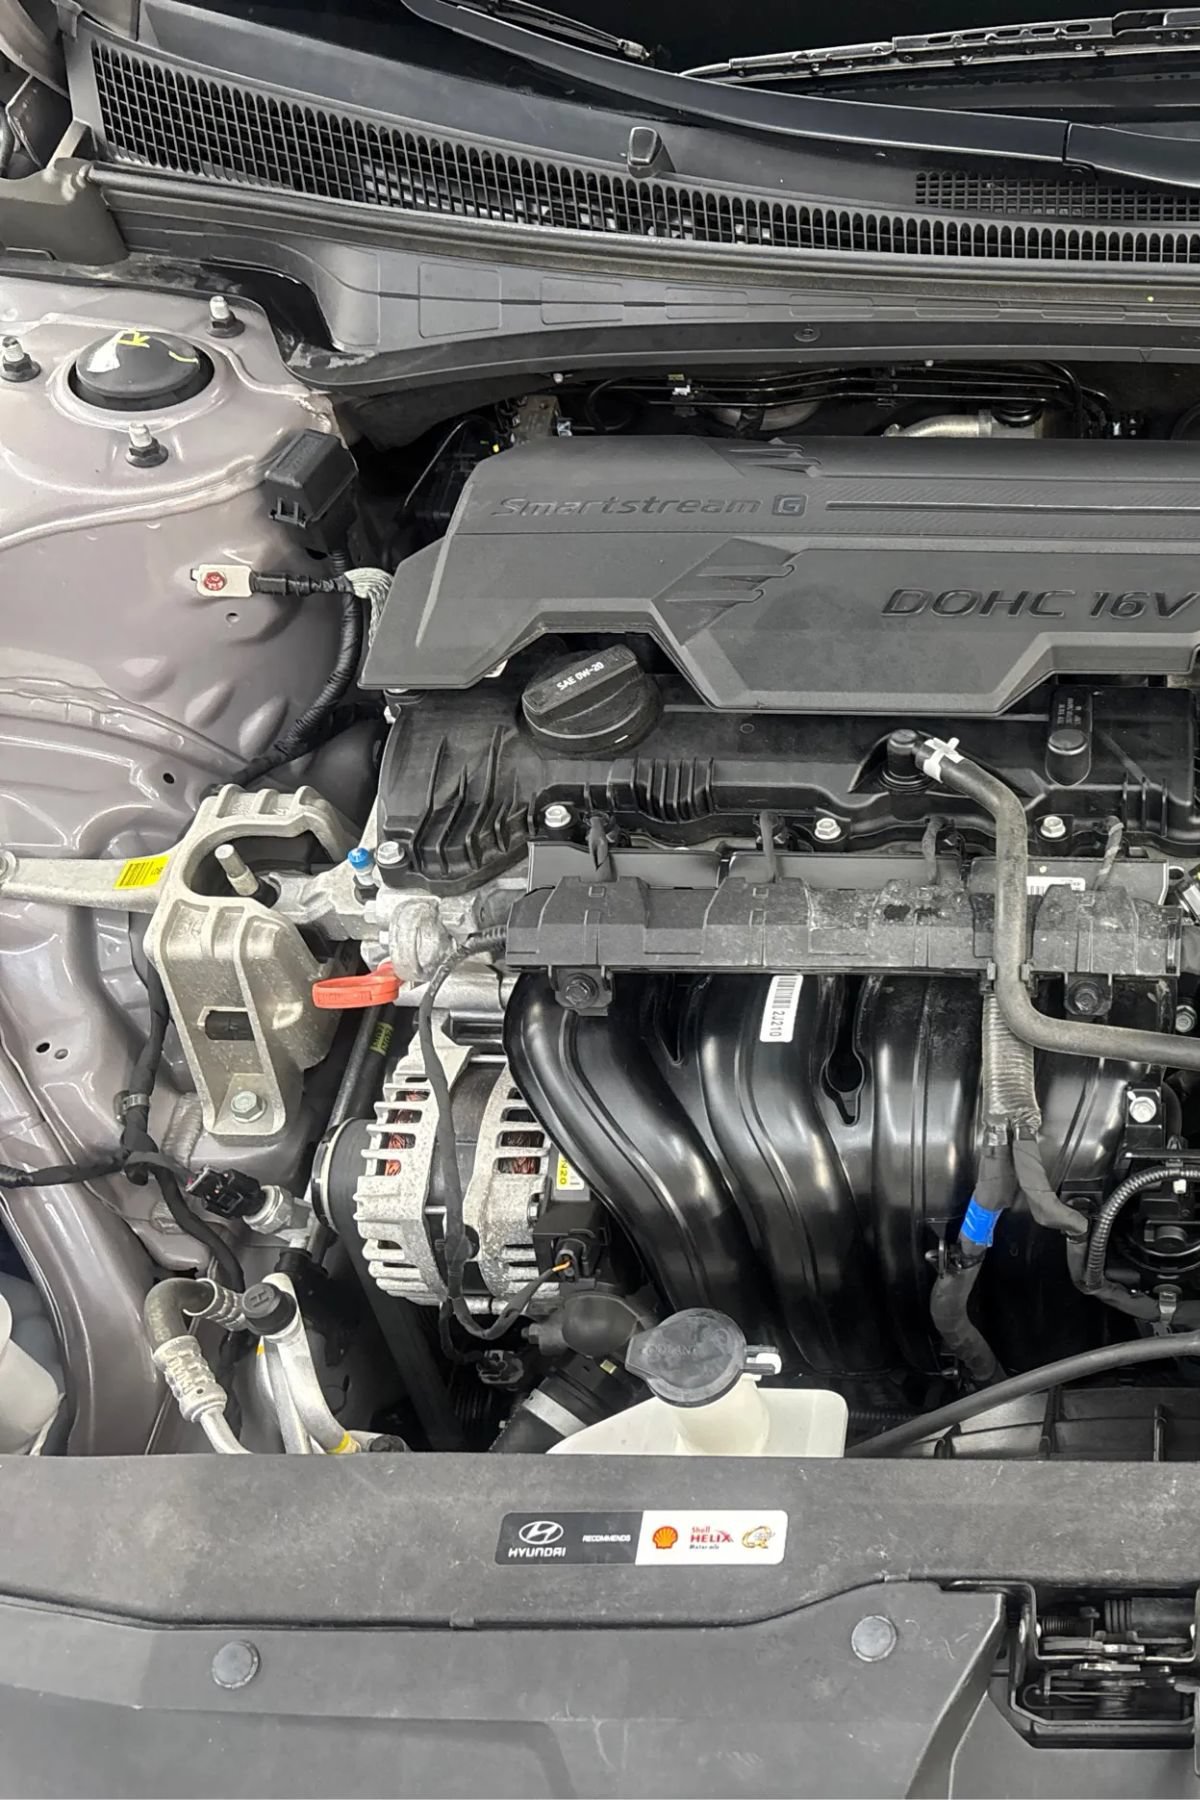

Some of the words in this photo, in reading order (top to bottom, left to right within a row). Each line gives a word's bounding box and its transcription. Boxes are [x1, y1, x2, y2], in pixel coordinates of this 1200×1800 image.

[490, 496, 762, 517] Smartstream
[882, 588, 1076, 618] DOHC
[1088, 590, 1200, 619] 16V
[556, 676, 577, 691] SAE
[574, 661, 605, 681] 0W-20
[768, 1010, 786, 1037] 2J210
[690, 1532, 733, 1543] HELIX
[691, 1525, 711, 1534] Shell
[582, 1533, 631, 1543] RECOMMENDS
[508, 1547, 567, 1558] HYUNDAI
